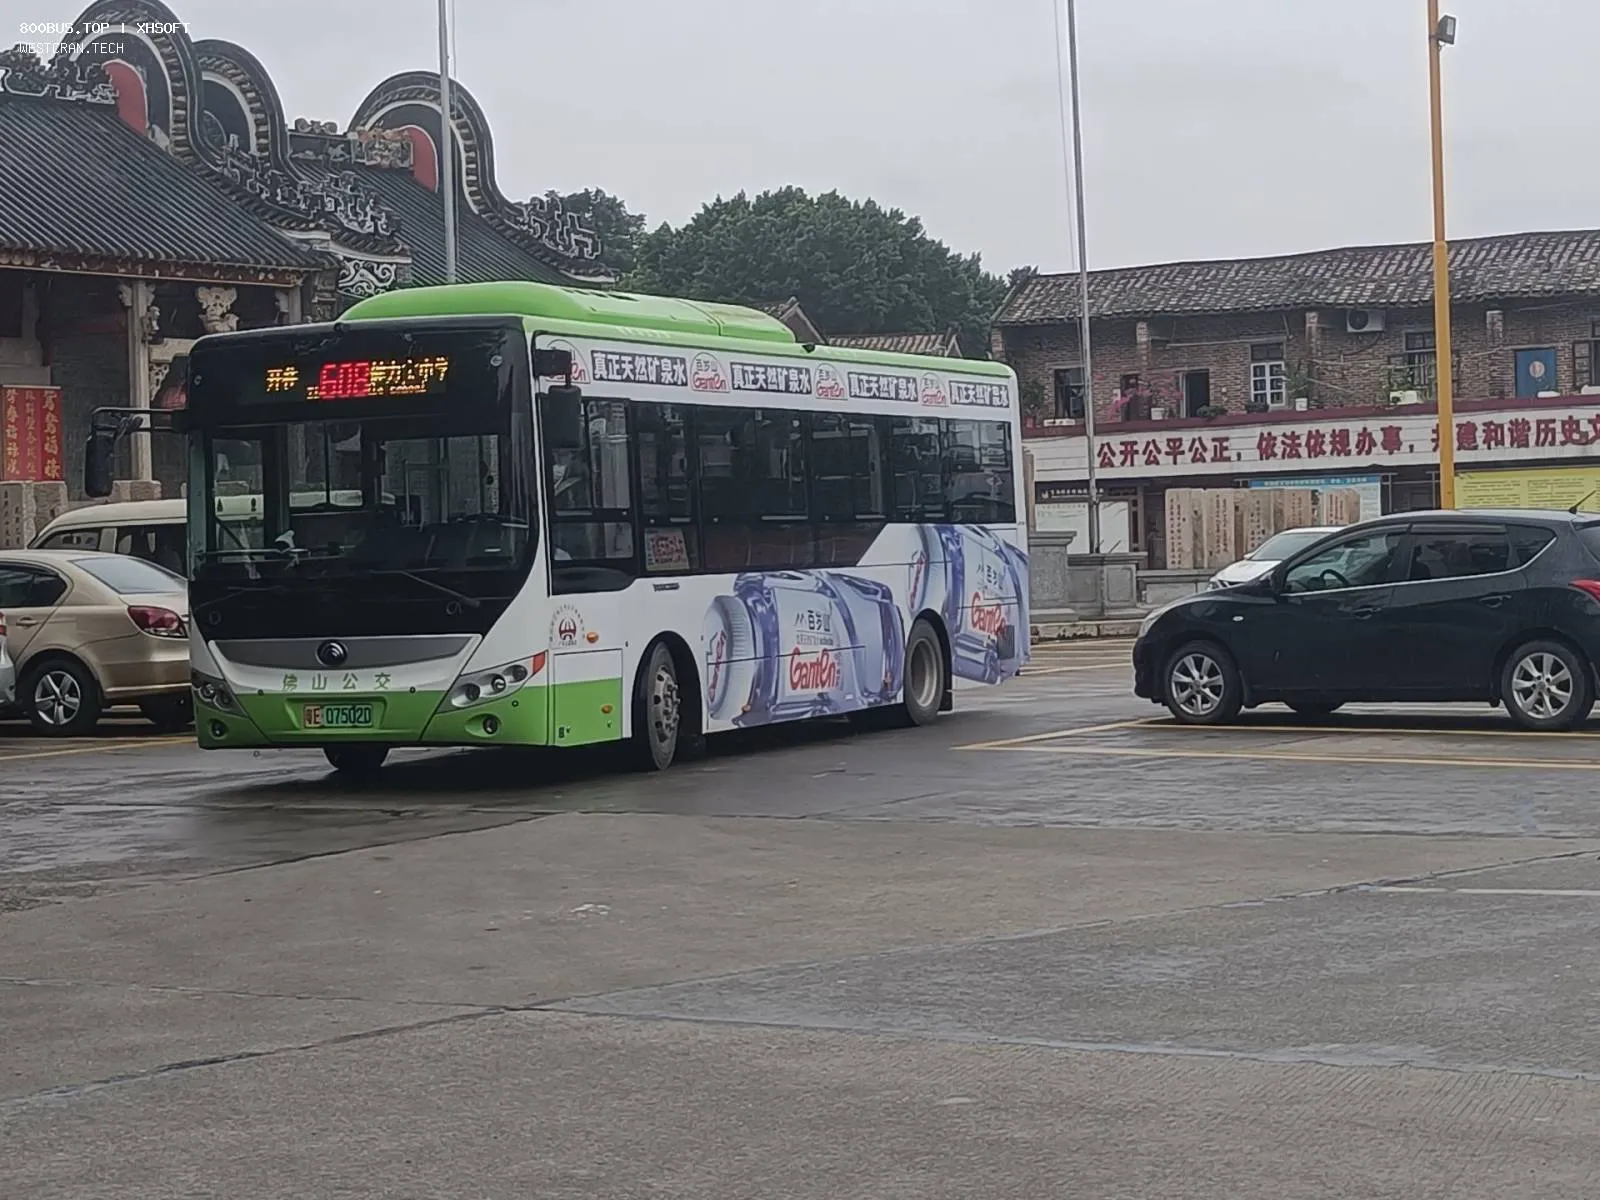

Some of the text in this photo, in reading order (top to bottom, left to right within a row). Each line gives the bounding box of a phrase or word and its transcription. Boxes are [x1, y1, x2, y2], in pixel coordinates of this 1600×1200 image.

[321, 362, 369, 399] 608
[593, 352, 686, 386] 真正天然矿泉水
[732, 364, 811, 394] 真正天然矿泉水
[849, 374, 918, 401] 真正天然矿泉水
[282, 672, 392, 691] 佛山公交
